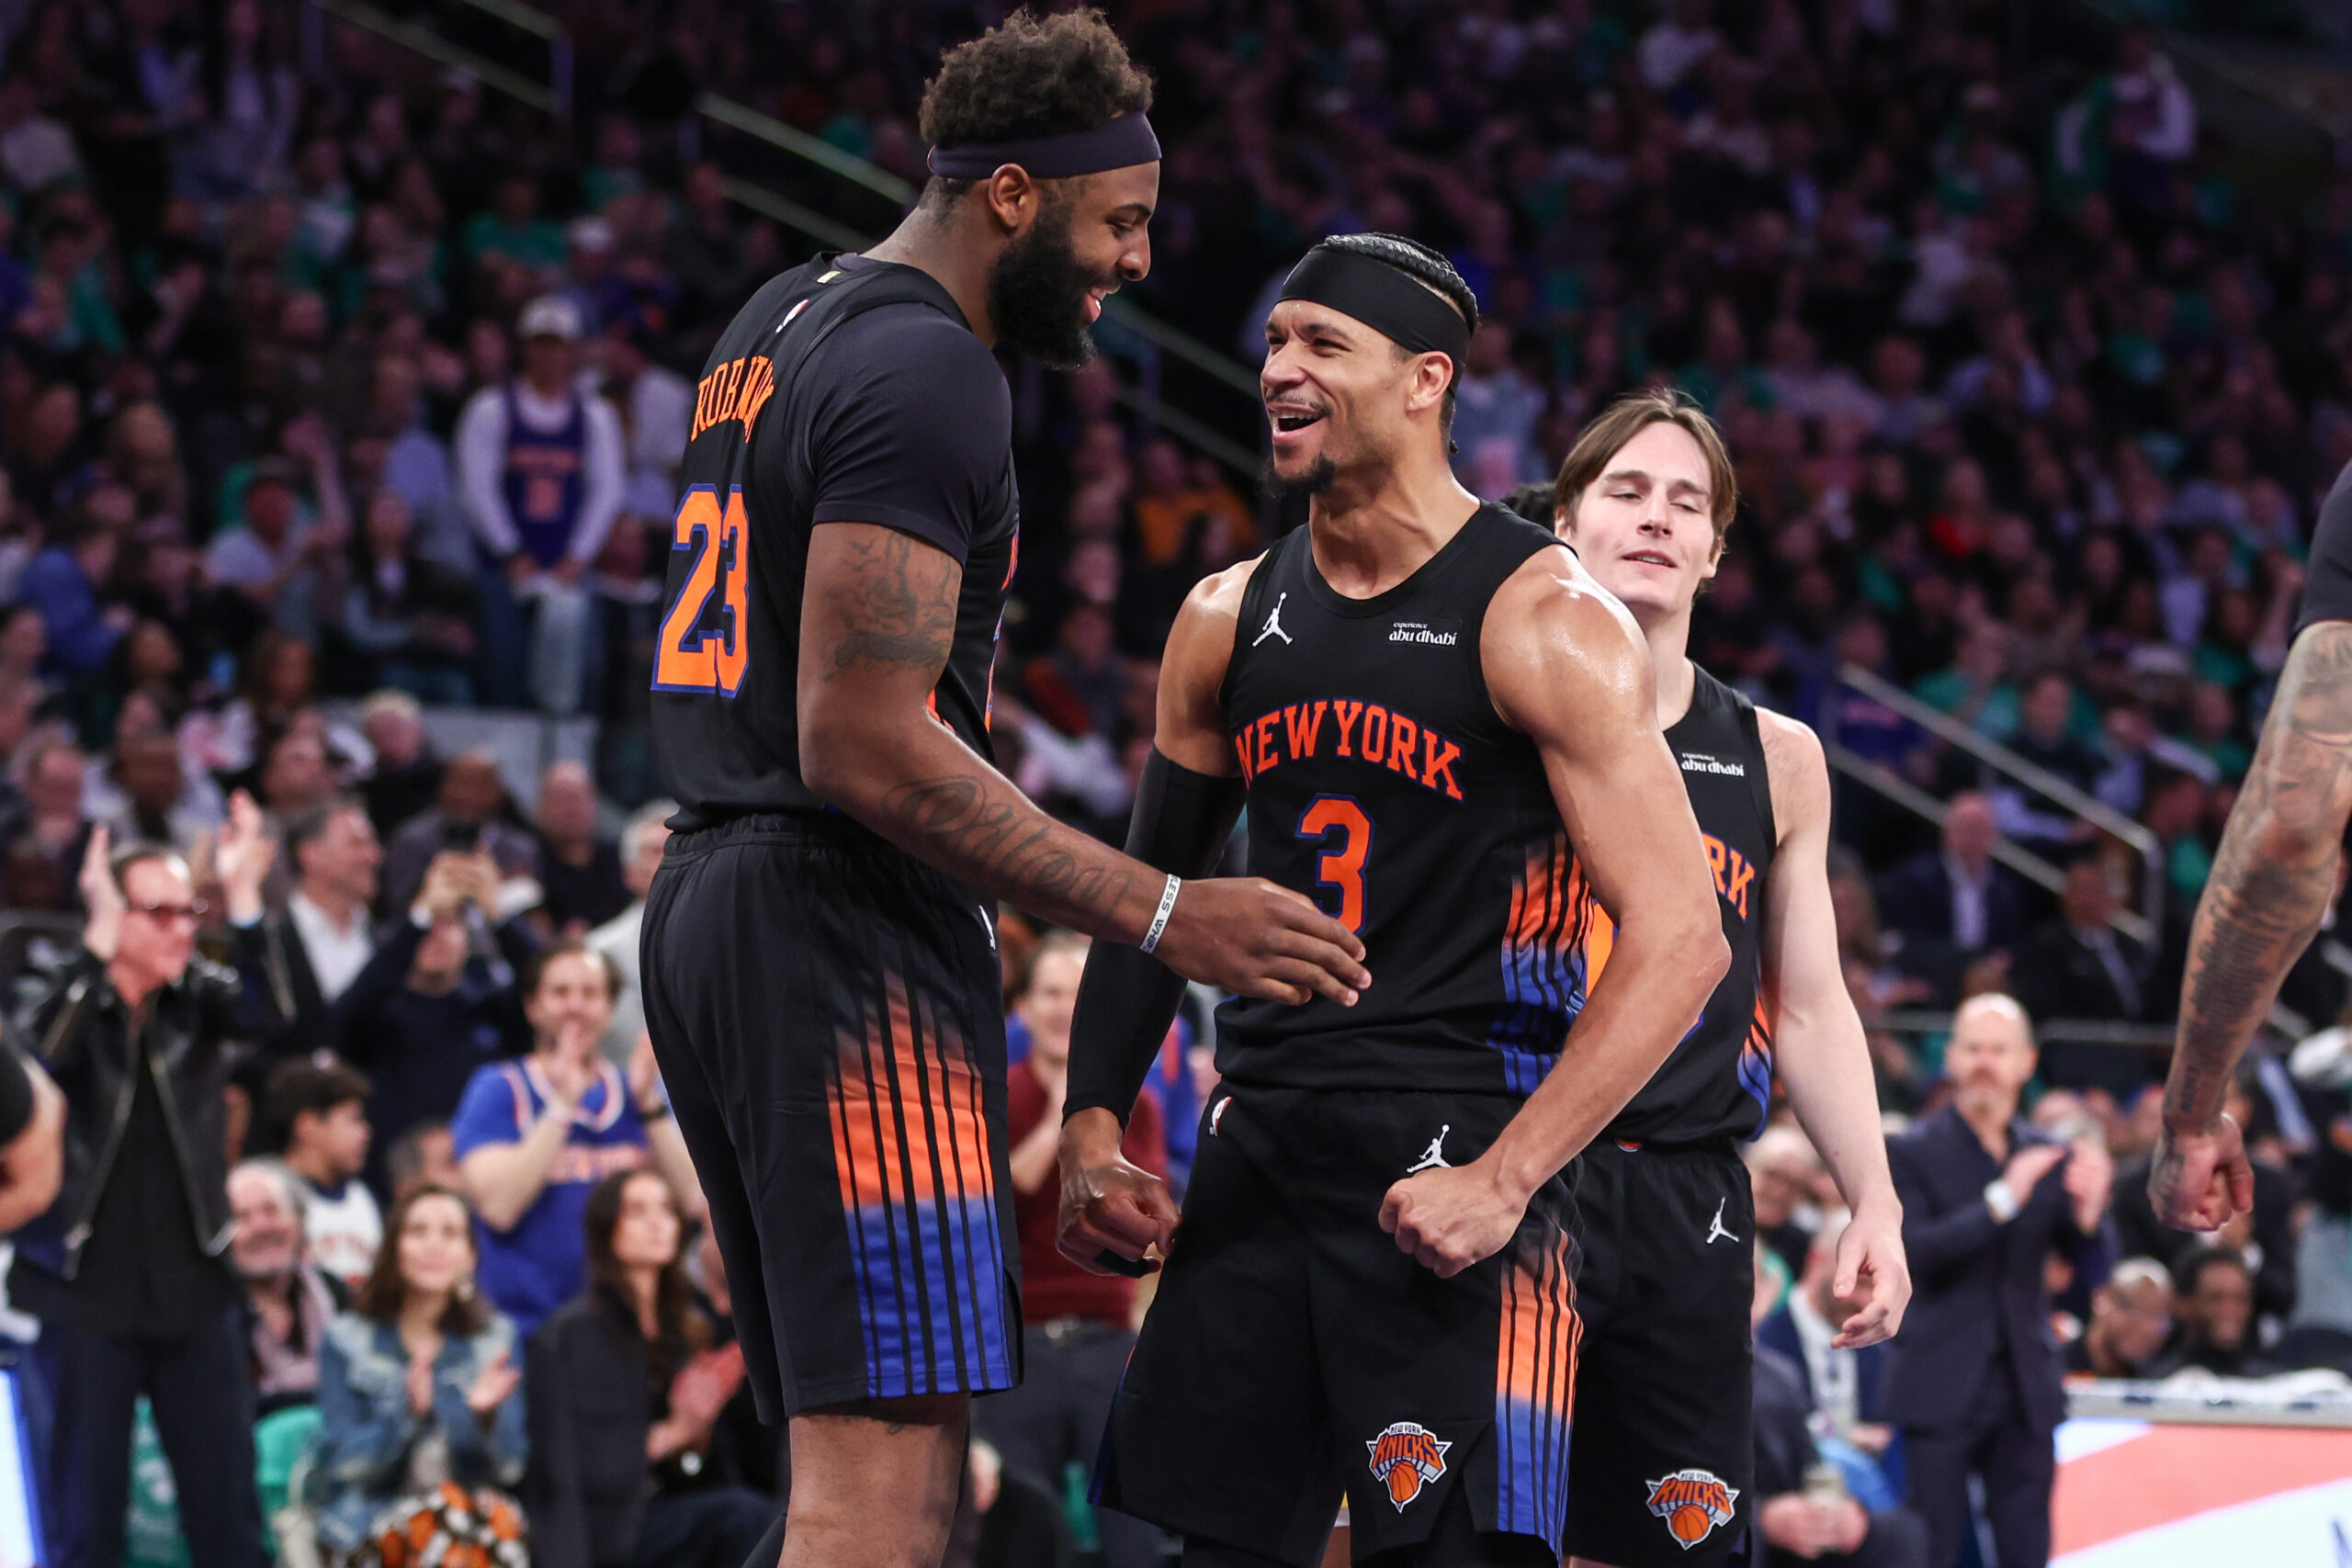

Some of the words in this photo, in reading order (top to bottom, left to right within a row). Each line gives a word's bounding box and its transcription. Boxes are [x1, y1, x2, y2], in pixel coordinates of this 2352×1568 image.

[650, 483, 750, 698] 23
[1388, 629, 1415, 642] abu
[1416, 630, 1458, 645] dhabi
[1393, 621, 1428, 629] experience
[1236, 700, 1329, 789] NEW
[1332, 698, 1464, 802] YORK
[1681, 759, 1707, 773] abu
[1707, 761, 1745, 777] dhabi
[1295, 793, 1375, 933] 3
[1700, 830, 1757, 921] RK
[1405, 1424, 1421, 1434] YORK
[1371, 1433, 1443, 1471] KNICKS
[1650, 1477, 1732, 1516] KNICKS
